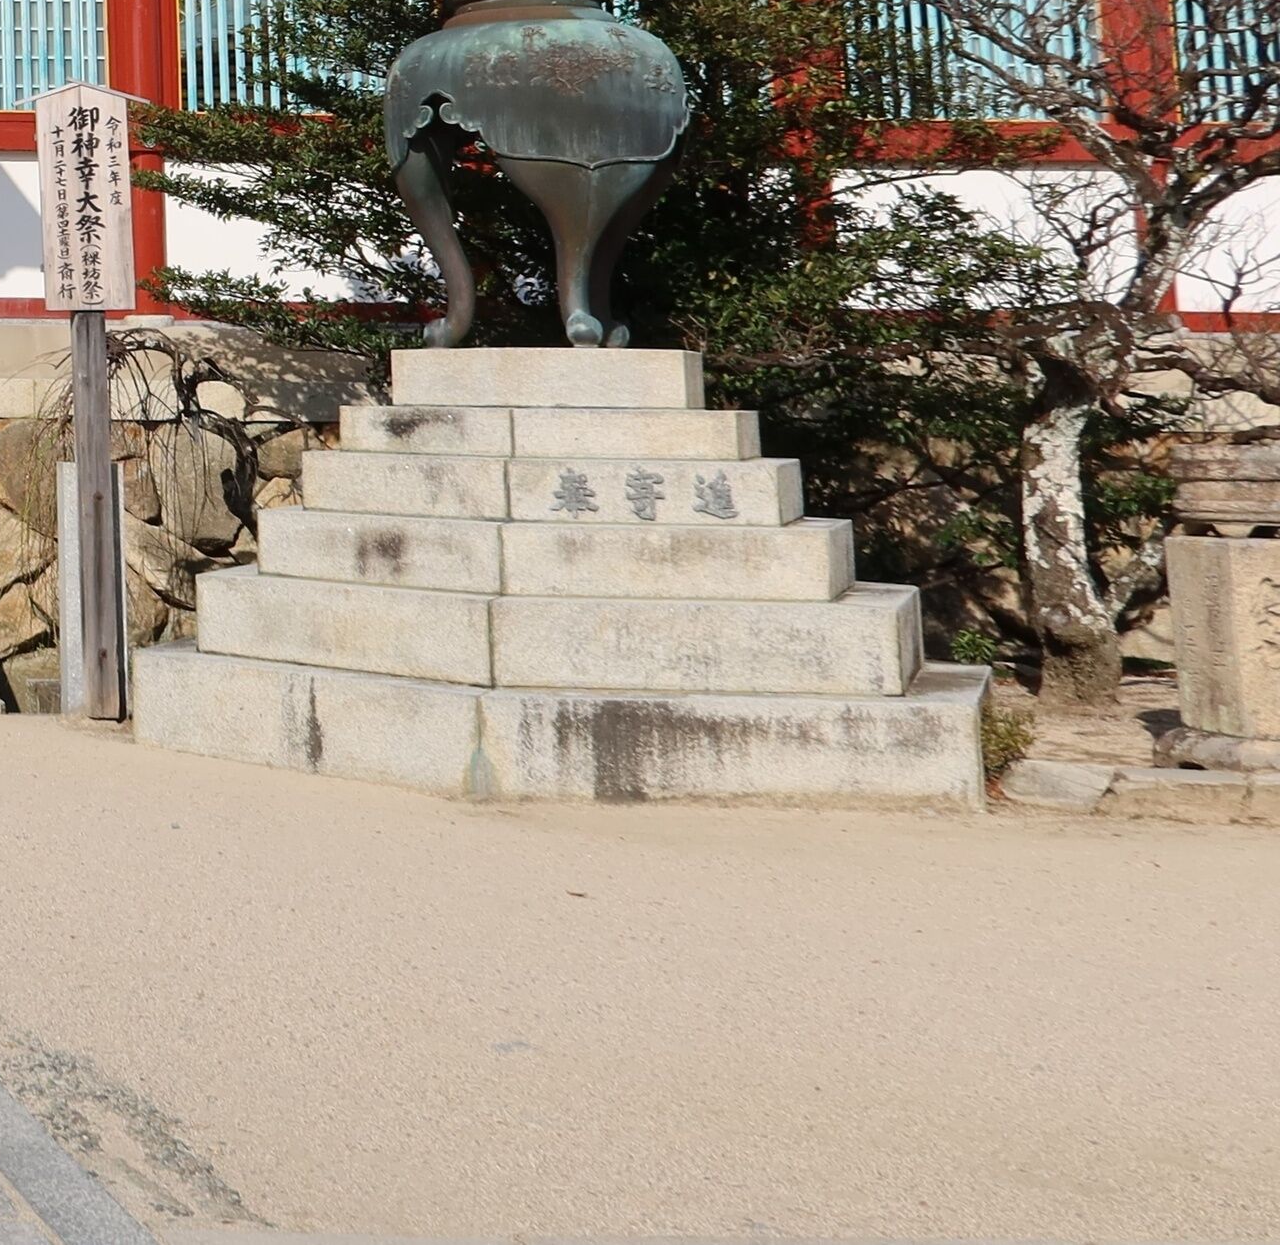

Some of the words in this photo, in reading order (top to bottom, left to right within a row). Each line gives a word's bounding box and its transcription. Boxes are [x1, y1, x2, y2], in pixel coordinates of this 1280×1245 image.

[105, 116, 123, 205] 令和三年度
